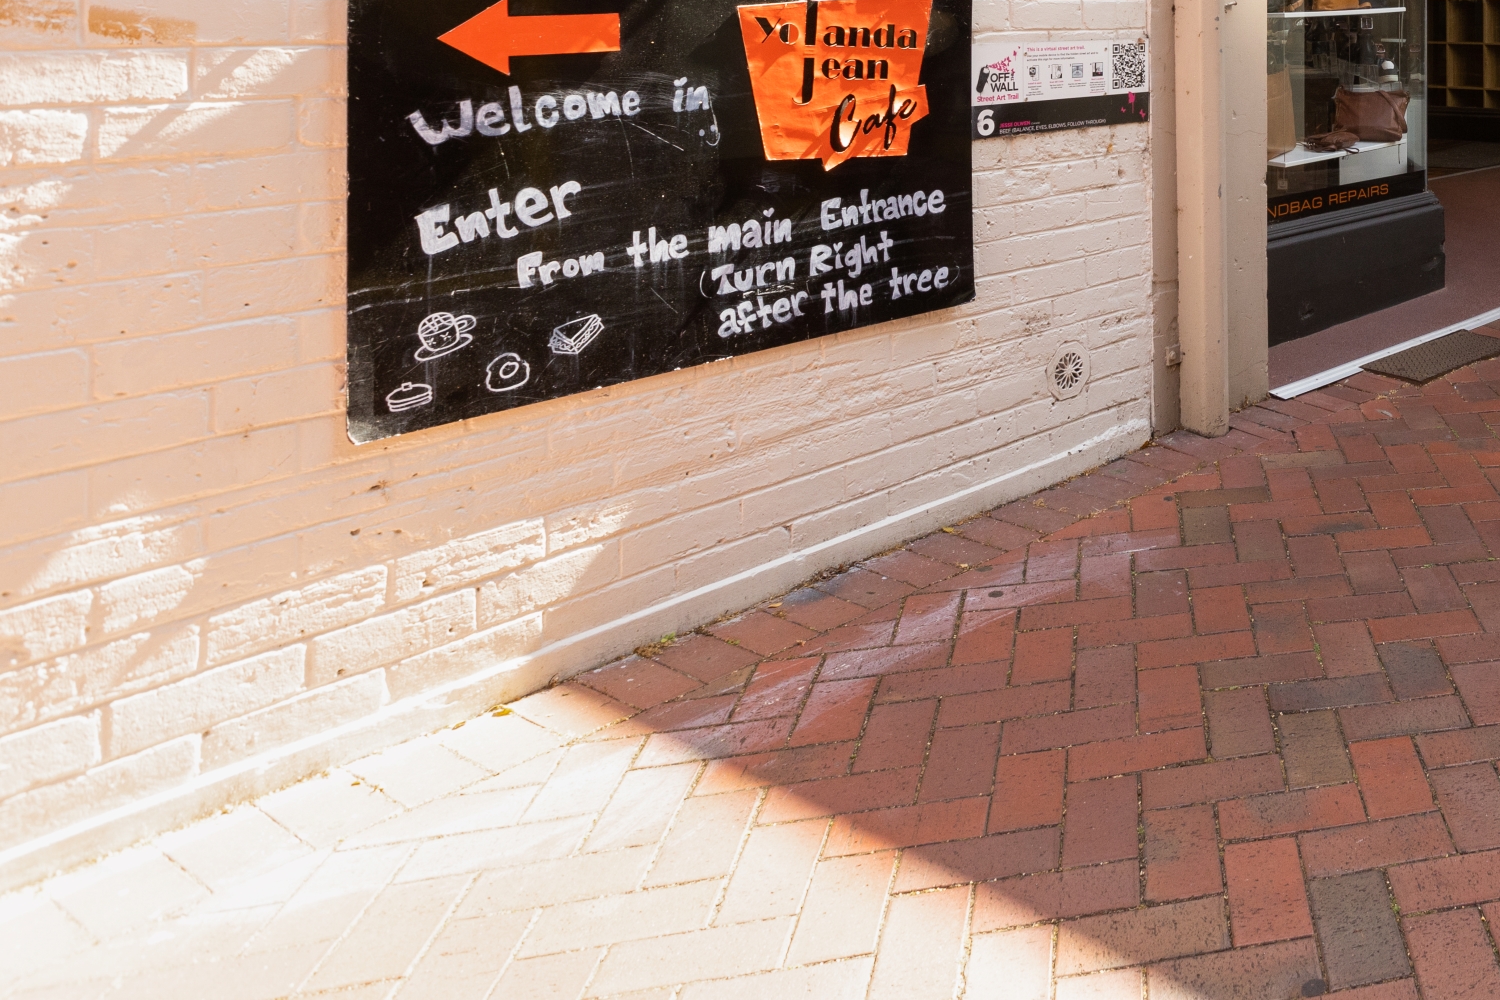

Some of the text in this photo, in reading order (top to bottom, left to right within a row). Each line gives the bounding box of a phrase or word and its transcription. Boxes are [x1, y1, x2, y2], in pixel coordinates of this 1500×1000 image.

[754, 0, 918, 50] Yolanda
[976, 95, 996, 103] Street
[1007, 92, 1020, 100] Trail
[990, 72, 1010, 83] OFF
[990, 81, 1019, 93] WALL
[405, 84, 642, 147] Welcome
[830, 83, 918, 155] Cafe
[976, 108, 996, 137] 6
[414, 180, 582, 255] Enter
[1328, 183, 1390, 206] REPAIRS
[516, 250, 605, 289] From
[626, 226, 690, 268] the
[820, 188, 948, 231] Entrance
[809, 230, 895, 279] Right
[717, 281, 810, 339] after
[820, 279, 874, 314] the
